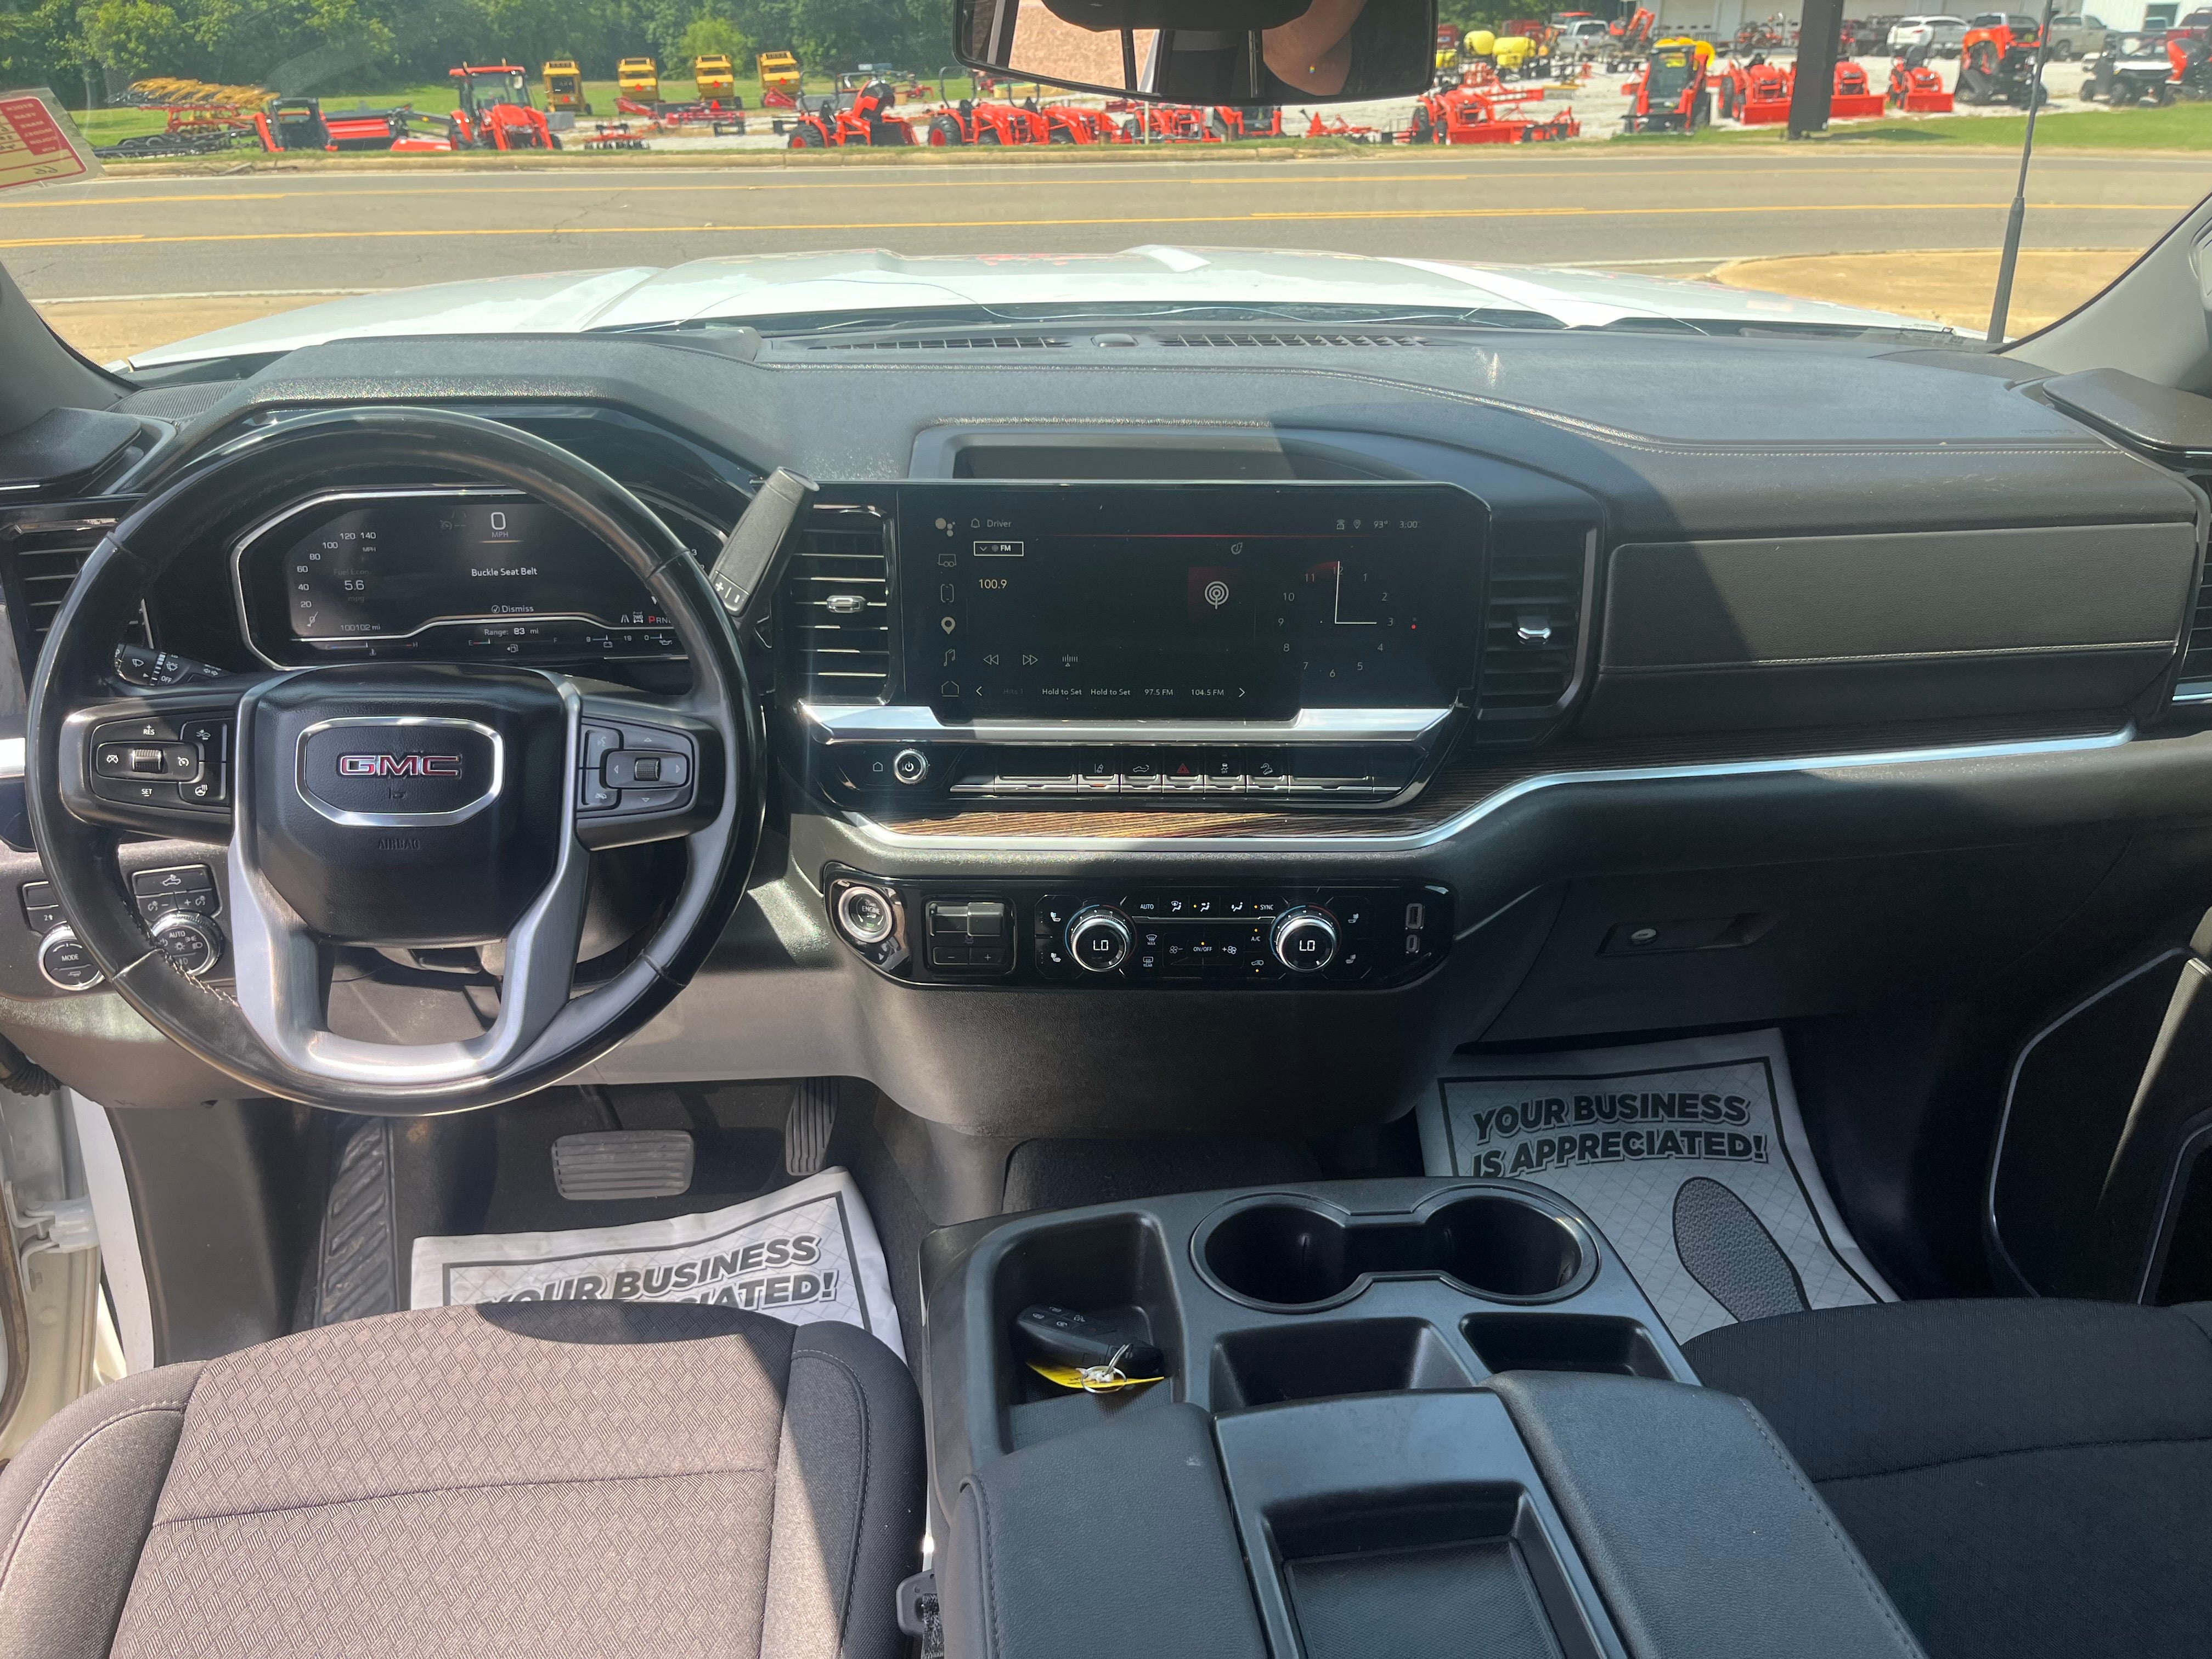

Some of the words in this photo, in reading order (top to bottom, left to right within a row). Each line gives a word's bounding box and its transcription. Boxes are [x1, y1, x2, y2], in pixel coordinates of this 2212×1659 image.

[490, 511, 506, 531] 0
[987, 519, 1012, 528] Driver
[471, 568, 499, 577] Buckle
[500, 567, 519, 575] Seat
[521, 567, 538, 575] Belt
[1333, 566, 1344, 575] 12
[1305, 573, 1315, 582] 11
[1363, 573, 1367, 582] 1
[345, 580, 365, 591] 5.6
[979, 579, 1007, 589] 100.9
[1283, 592, 1295, 601] 10
[1381, 592, 1387, 601] 2
[501, 605, 534, 613] Dismiss
[1278, 618, 1284, 627] 9
[1387, 618, 1393, 626] 3
[484, 628, 509, 637] Range:
[1283, 643, 1289, 652] 8
[1377, 643, 1383, 651] 4
[1303, 662, 1308, 670] 7
[1357, 662, 1363, 670] 5
[1329, 669, 1335, 678] 6
[340, 754, 459, 776] GMC
[379, 838, 421, 850] AIRBAG
[169, 930, 185, 938] AUTO
[1093, 940, 1109, 951] LO
[1299, 940, 1316, 951] LO
[1472, 1097, 1570, 1141] YOUR
[1573, 1093, 1748, 1125] BUSINESS
[1472, 1149, 1503, 1177] IS
[1509, 1129, 1768, 1175] APPRECIATED!
[612, 1234, 817, 1300] BUSINESS
